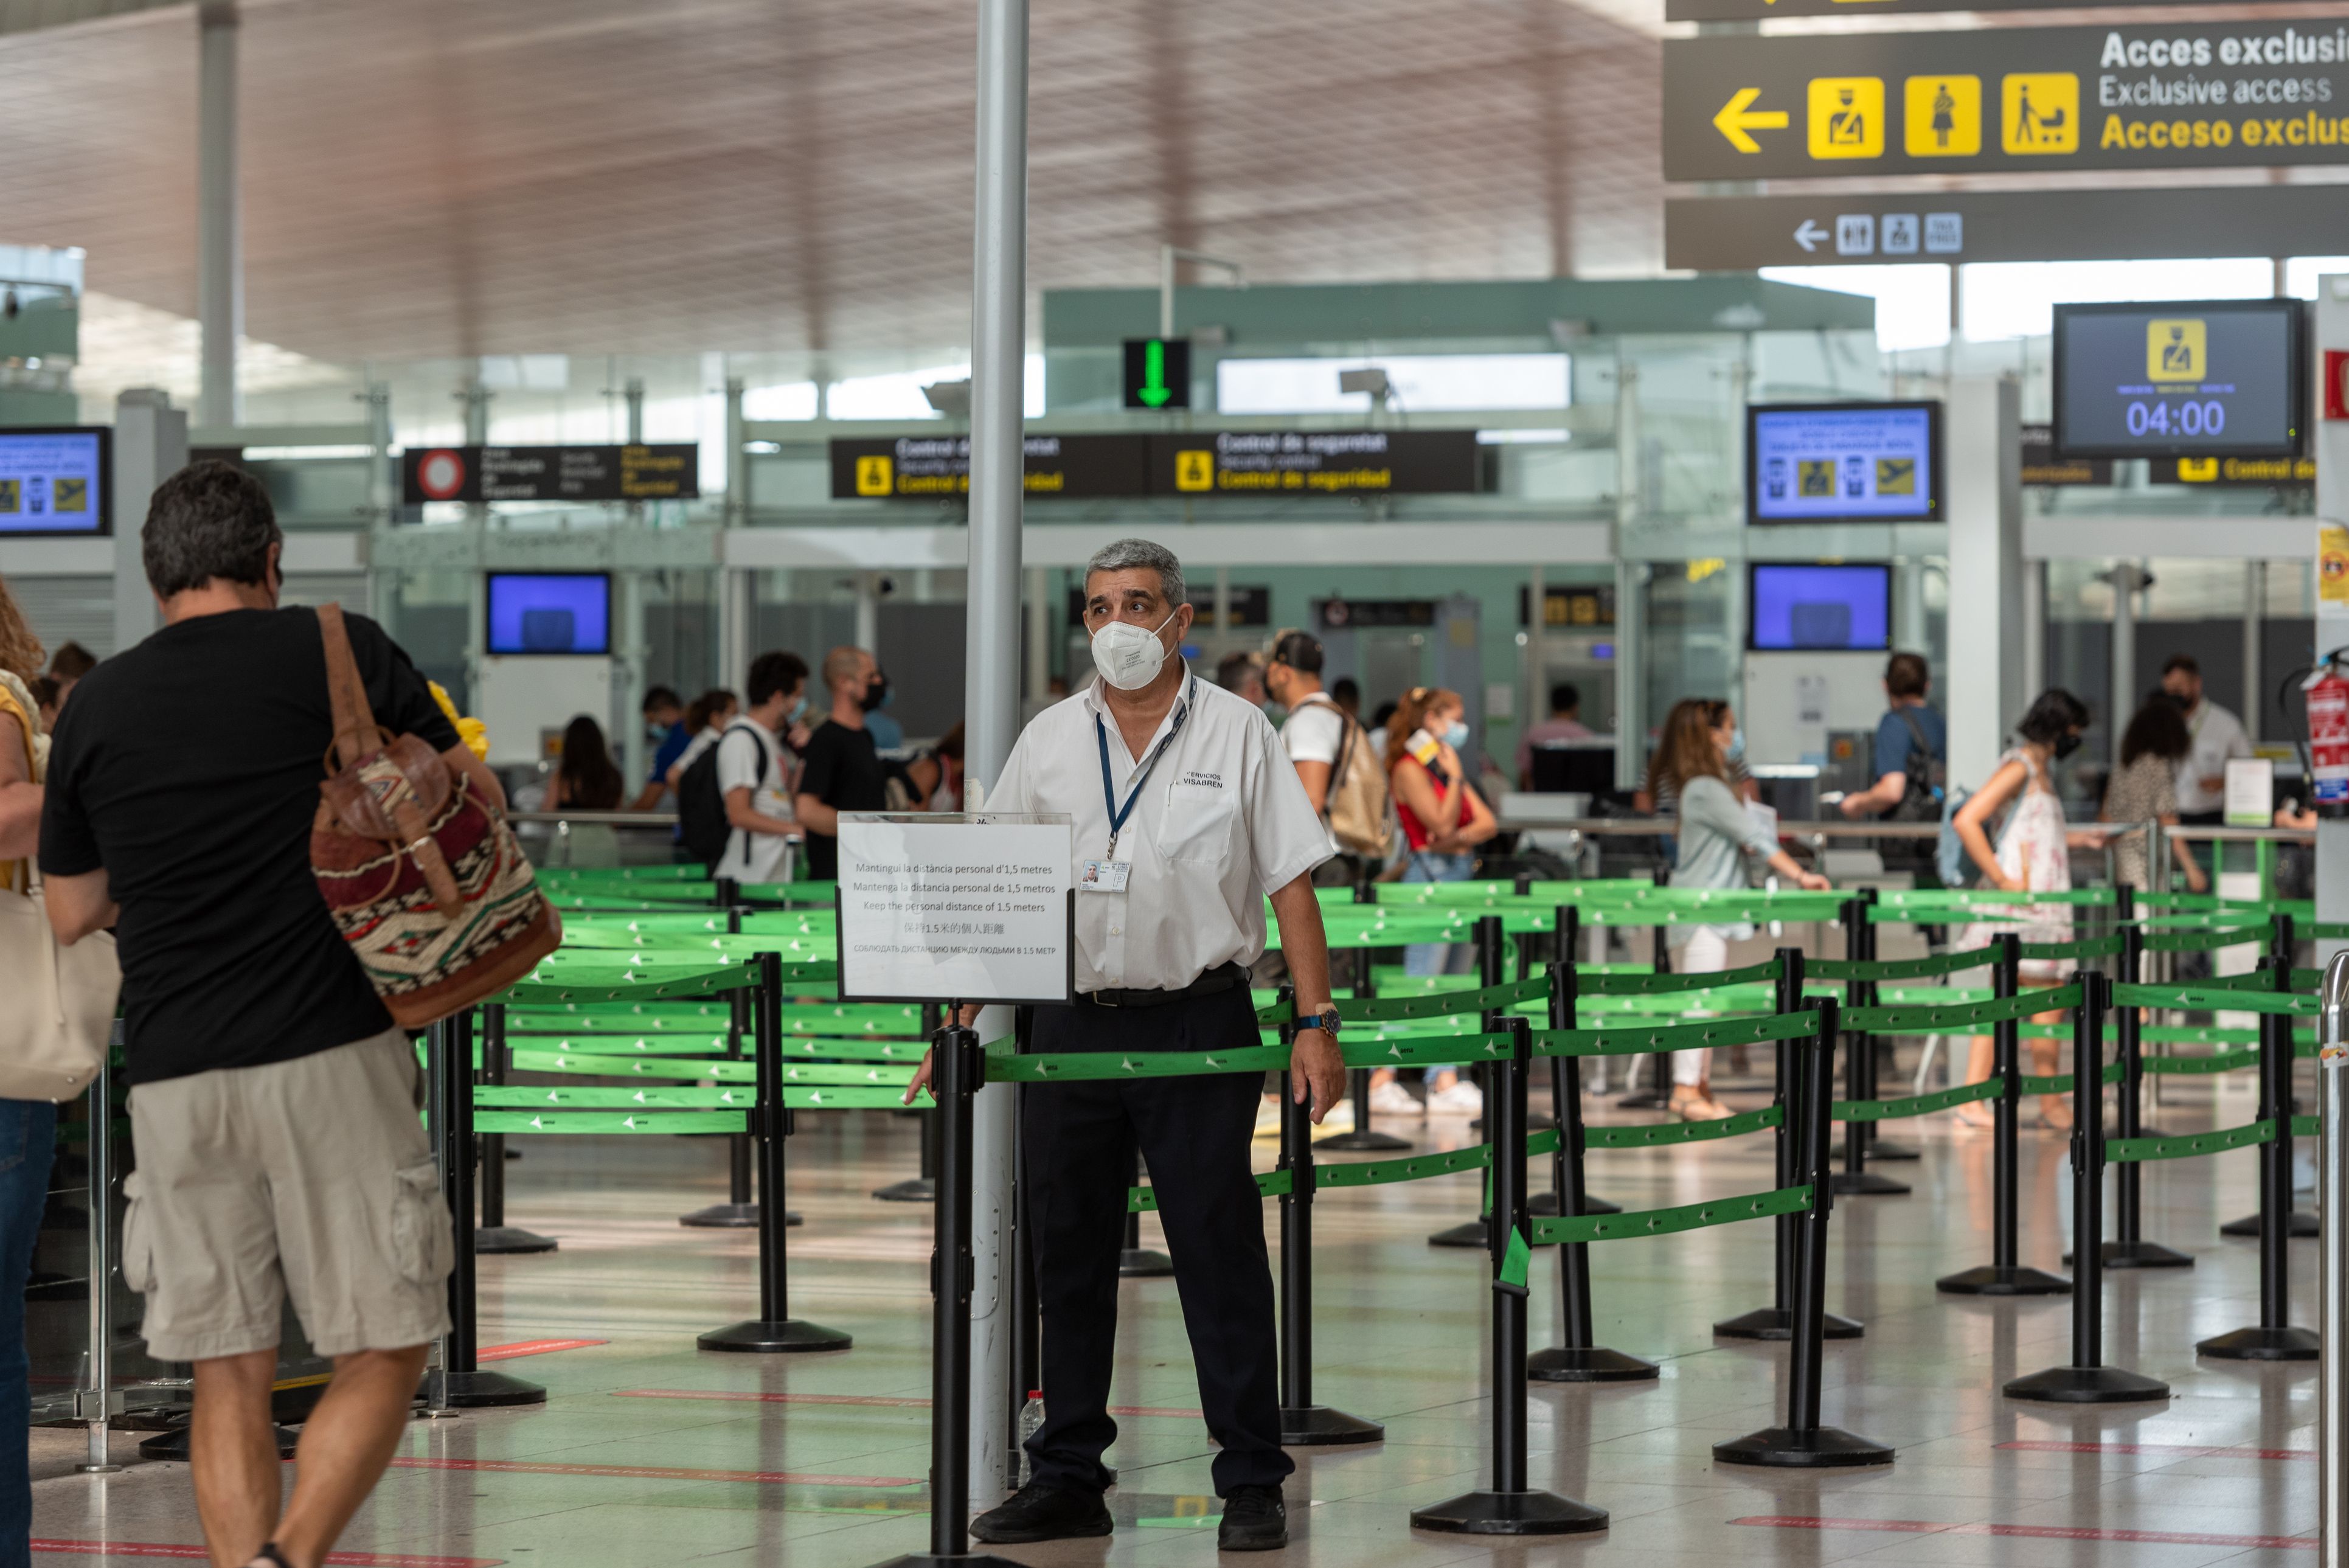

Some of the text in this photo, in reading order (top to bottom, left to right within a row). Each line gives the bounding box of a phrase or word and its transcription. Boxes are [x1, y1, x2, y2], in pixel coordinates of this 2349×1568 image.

[2100, 27, 2349, 68] Acces exclusi
[2099, 73, 2333, 107] Exclusive access
[2100, 114, 2233, 150] Acceso
[2126, 400, 2226, 437] 04:00
[2224, 457, 2291, 479] Control
[1187, 771, 1221, 780] ERVICIOS
[1184, 779, 1223, 788] VISABREN
[856, 864, 901, 874] Mantingui
[904, 864, 911, 872] la
[914, 864, 952, 873] distància
[955, 864, 994, 875] personal
[996, 865, 1018, 875] d'1,5
[853, 883, 1055, 894] Mantenga la distancia personal de 1,5 metros
[864, 901, 886, 911] Keep
[888, 901, 903, 910] the
[905, 901, 943, 912] personal
[946, 902, 983, 911] distance
[985, 902, 995, 911] of
[998, 903, 1010, 912] 1.5
[854, 945, 900, 953] СОБЛЮДАТЬ
[901, 945, 948, 954] ДИСТАНЦИЮ
